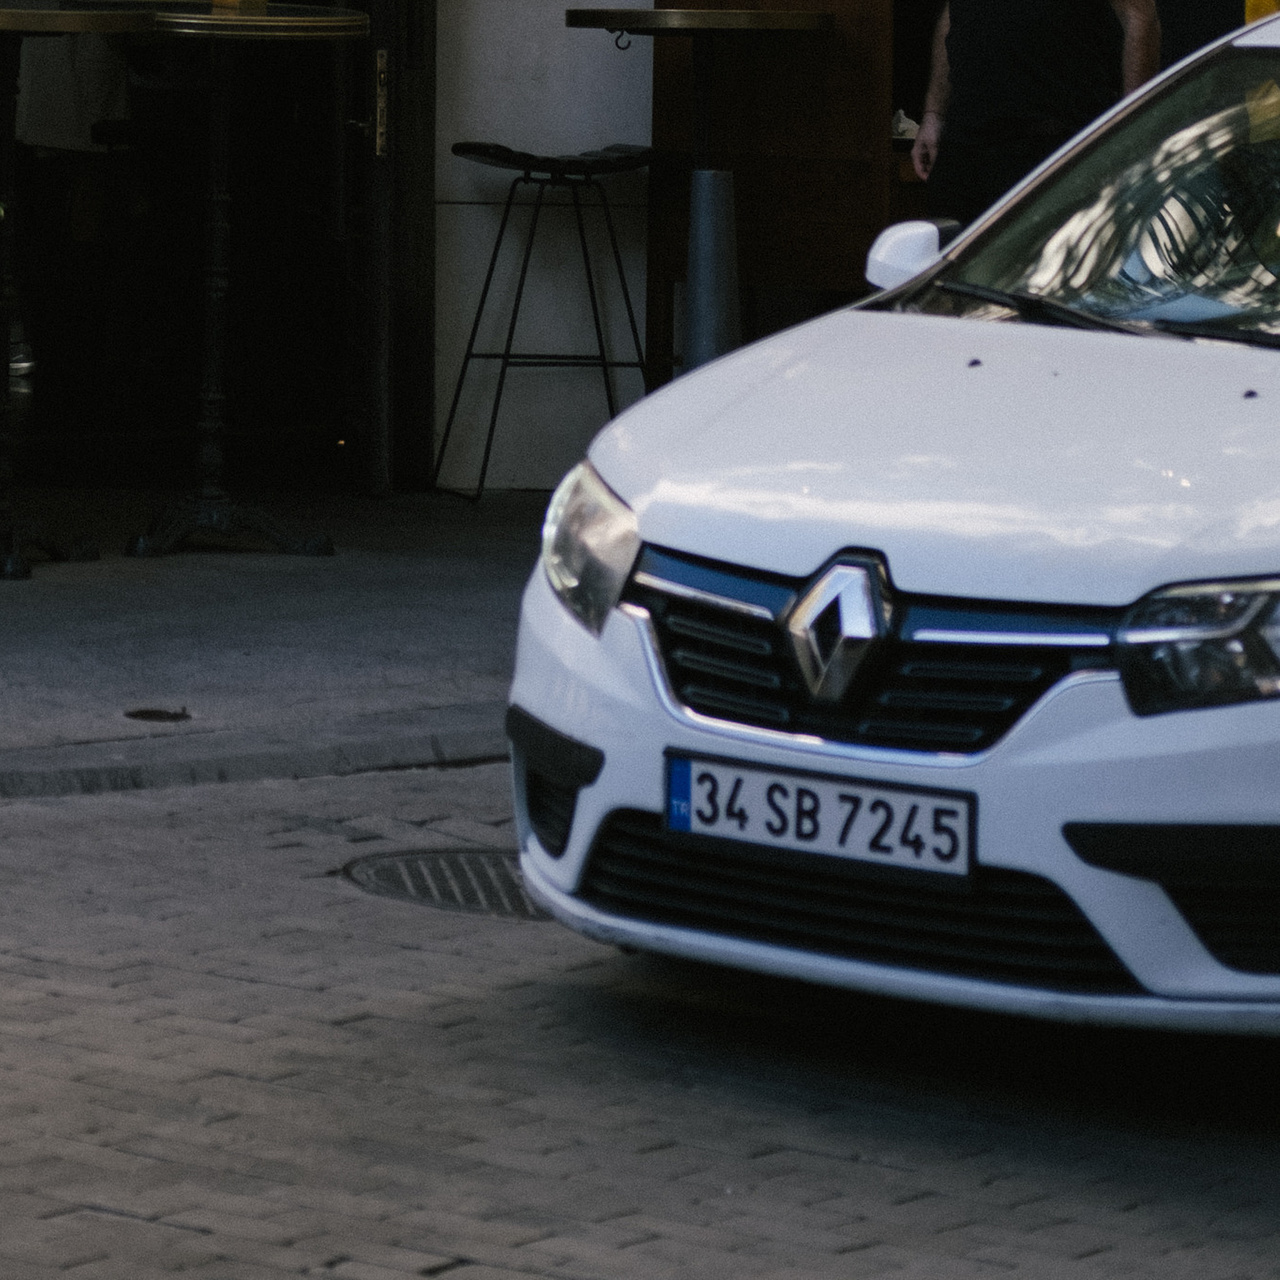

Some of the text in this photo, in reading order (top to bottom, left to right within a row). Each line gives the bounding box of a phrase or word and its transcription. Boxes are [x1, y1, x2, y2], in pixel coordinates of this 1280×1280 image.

[695, 772, 749, 832] 34
[765, 783, 820, 841] SB
[837, 793, 960, 863] 7245
